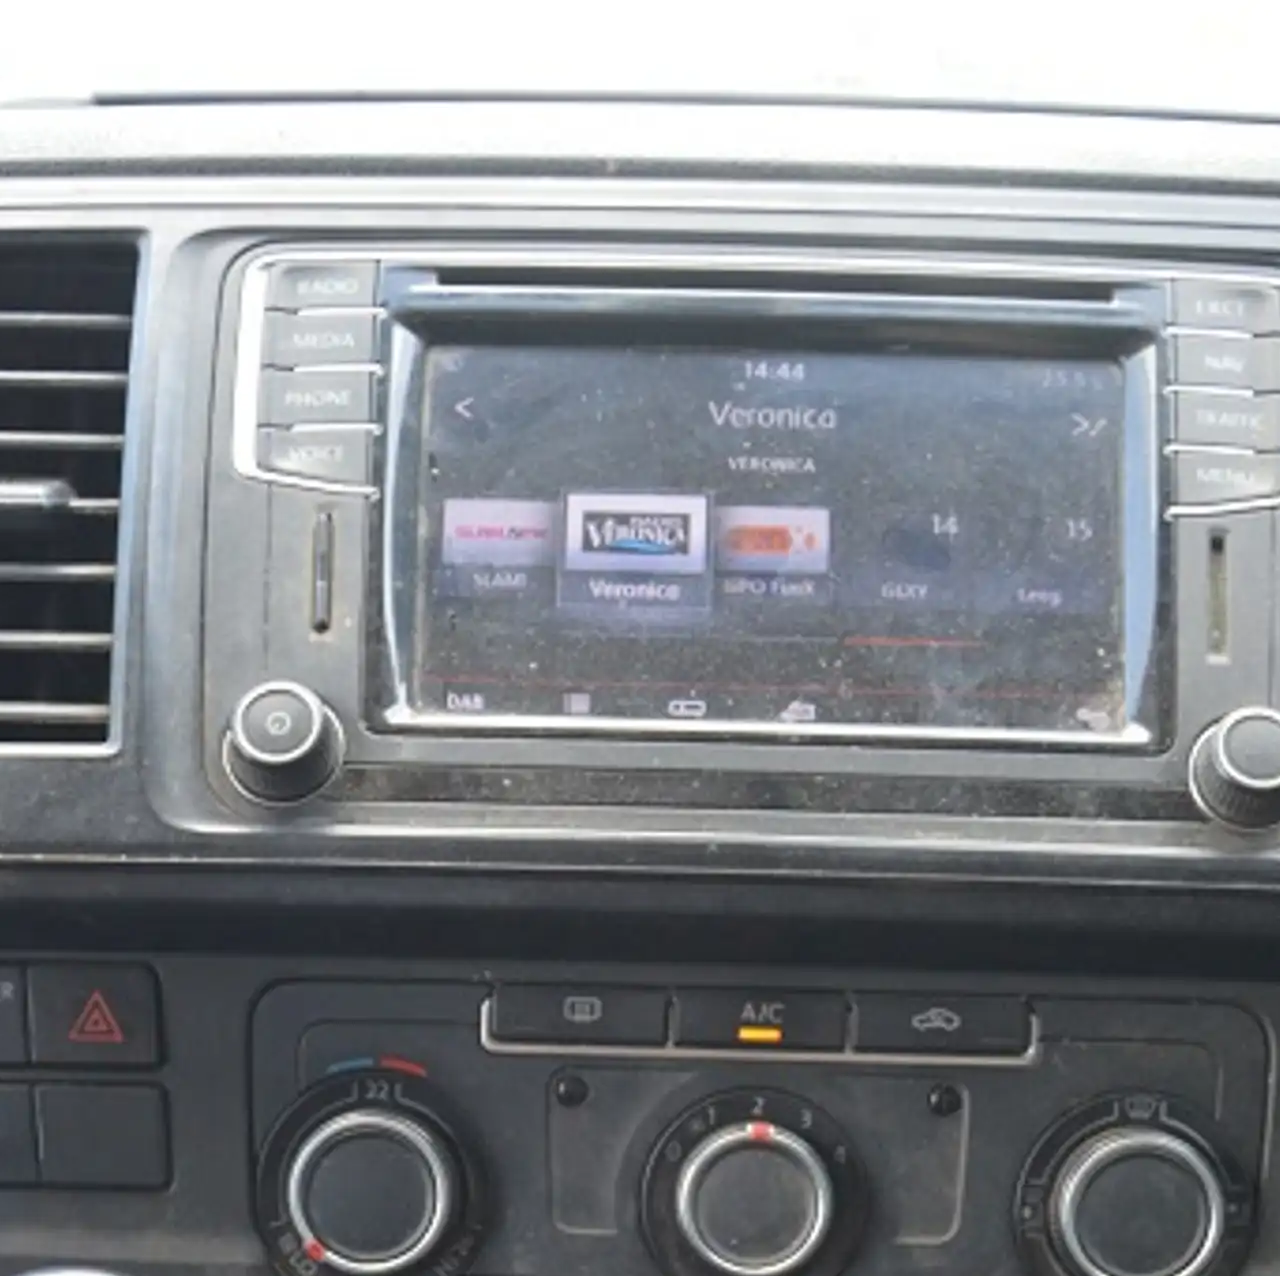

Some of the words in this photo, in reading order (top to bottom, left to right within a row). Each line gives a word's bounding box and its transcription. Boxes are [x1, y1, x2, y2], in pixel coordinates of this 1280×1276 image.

[745, 360, 805, 380] 14:44
[708, 400, 837, 429] Veronica
[932, 513, 959, 535] 14
[1067, 519, 1092, 541] 15
[588, 579, 680, 601] Veronica
[740, 1002, 785, 1024] A/C
